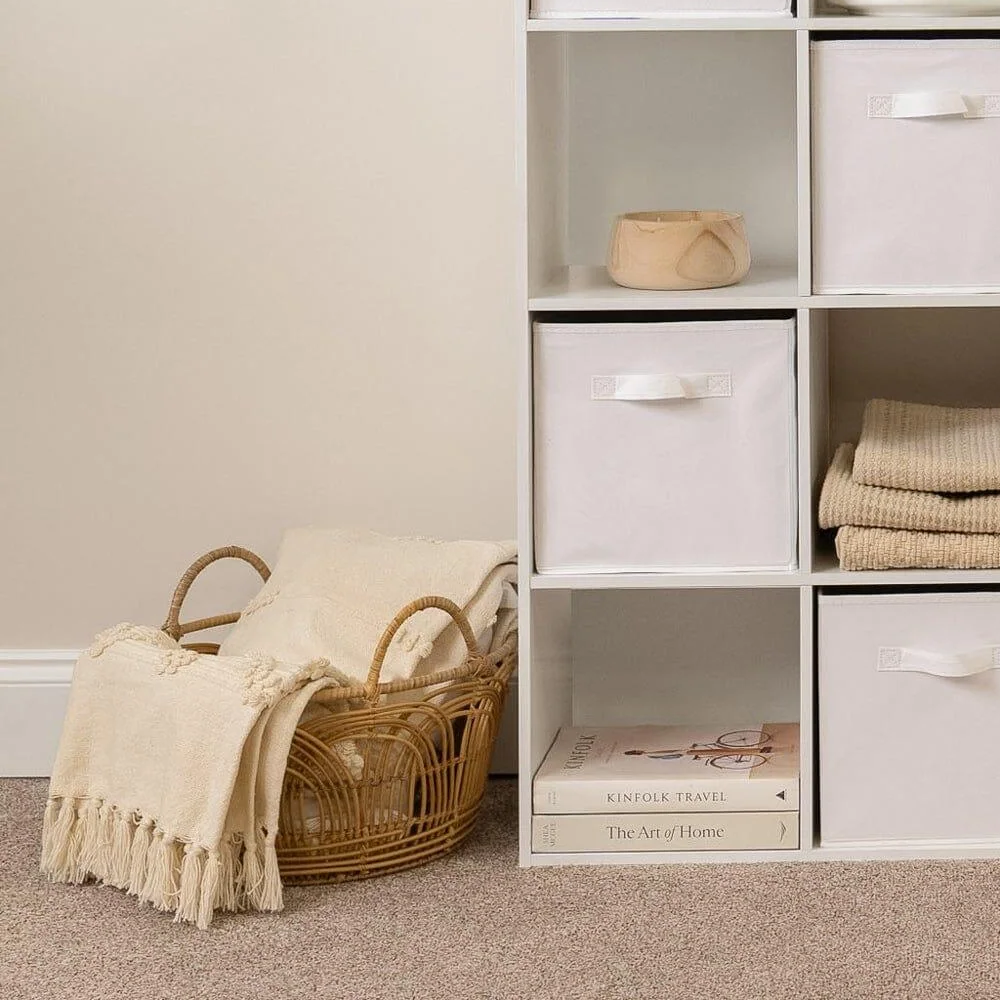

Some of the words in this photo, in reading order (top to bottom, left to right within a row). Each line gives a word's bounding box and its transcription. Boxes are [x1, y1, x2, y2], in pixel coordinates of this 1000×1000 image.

[563, 734, 598, 770] KINFOLK
[607, 793, 670, 803] KINFOLK
[676, 792, 728, 802] TRAVEL
[606, 826, 635, 840] The
[637, 826, 660, 839] Art
[664, 825, 679, 842] of
[680, 825, 725, 839] Home
